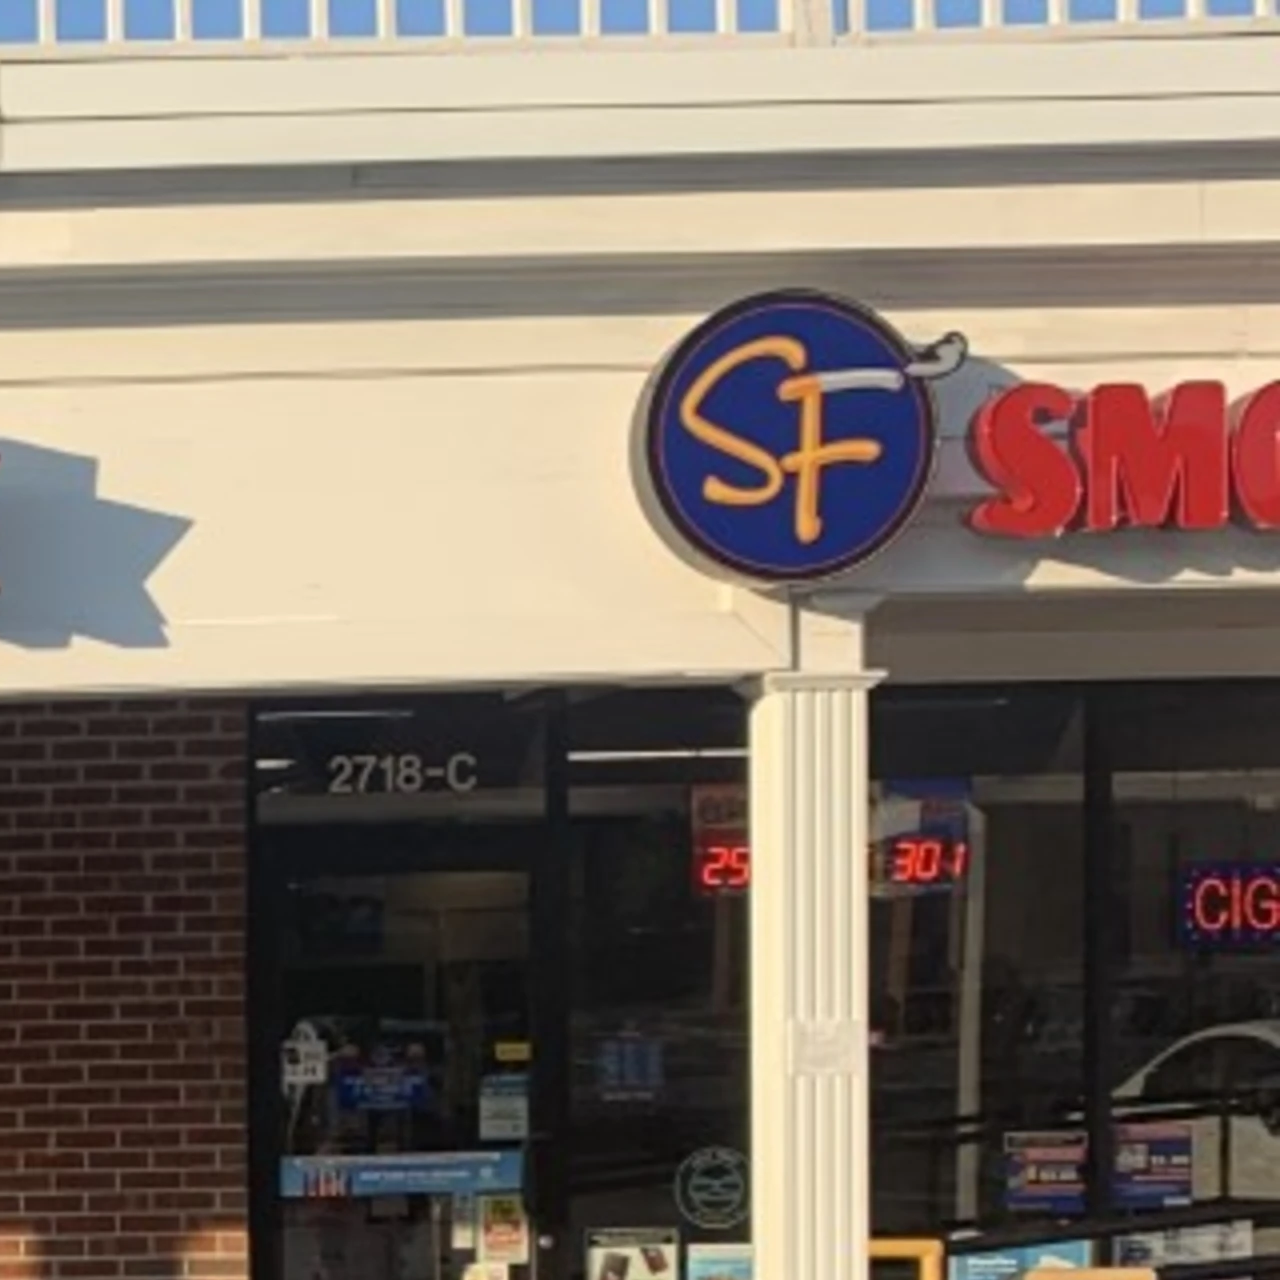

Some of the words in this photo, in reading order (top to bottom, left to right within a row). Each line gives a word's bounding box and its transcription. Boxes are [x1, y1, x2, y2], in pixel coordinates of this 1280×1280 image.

[680, 335, 905, 543] SF
[327, 752, 478, 794] 2718-C
[1195, 878, 1280, 931] CIG
